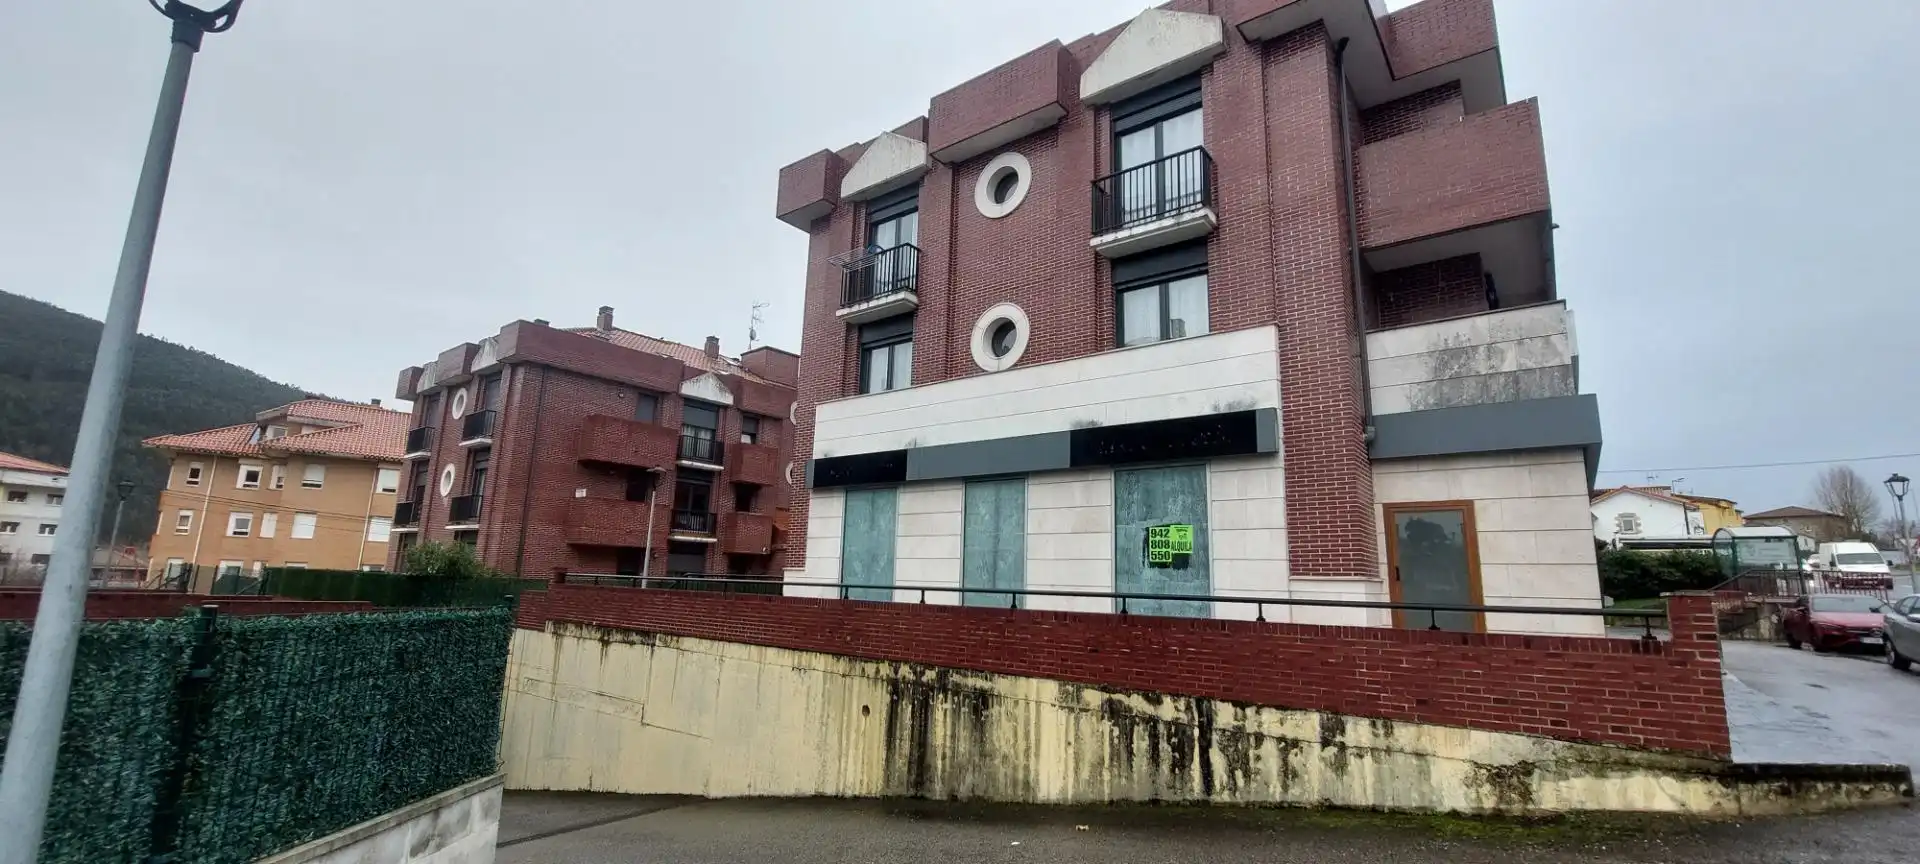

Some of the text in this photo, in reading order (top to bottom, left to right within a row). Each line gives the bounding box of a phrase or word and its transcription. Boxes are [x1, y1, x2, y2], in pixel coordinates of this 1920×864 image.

[1150, 528, 1170, 538] 942
[1150, 540, 1170, 549] 808
[1171, 541, 1192, 552] ALQUILA
[1151, 551, 1170, 560] 550
